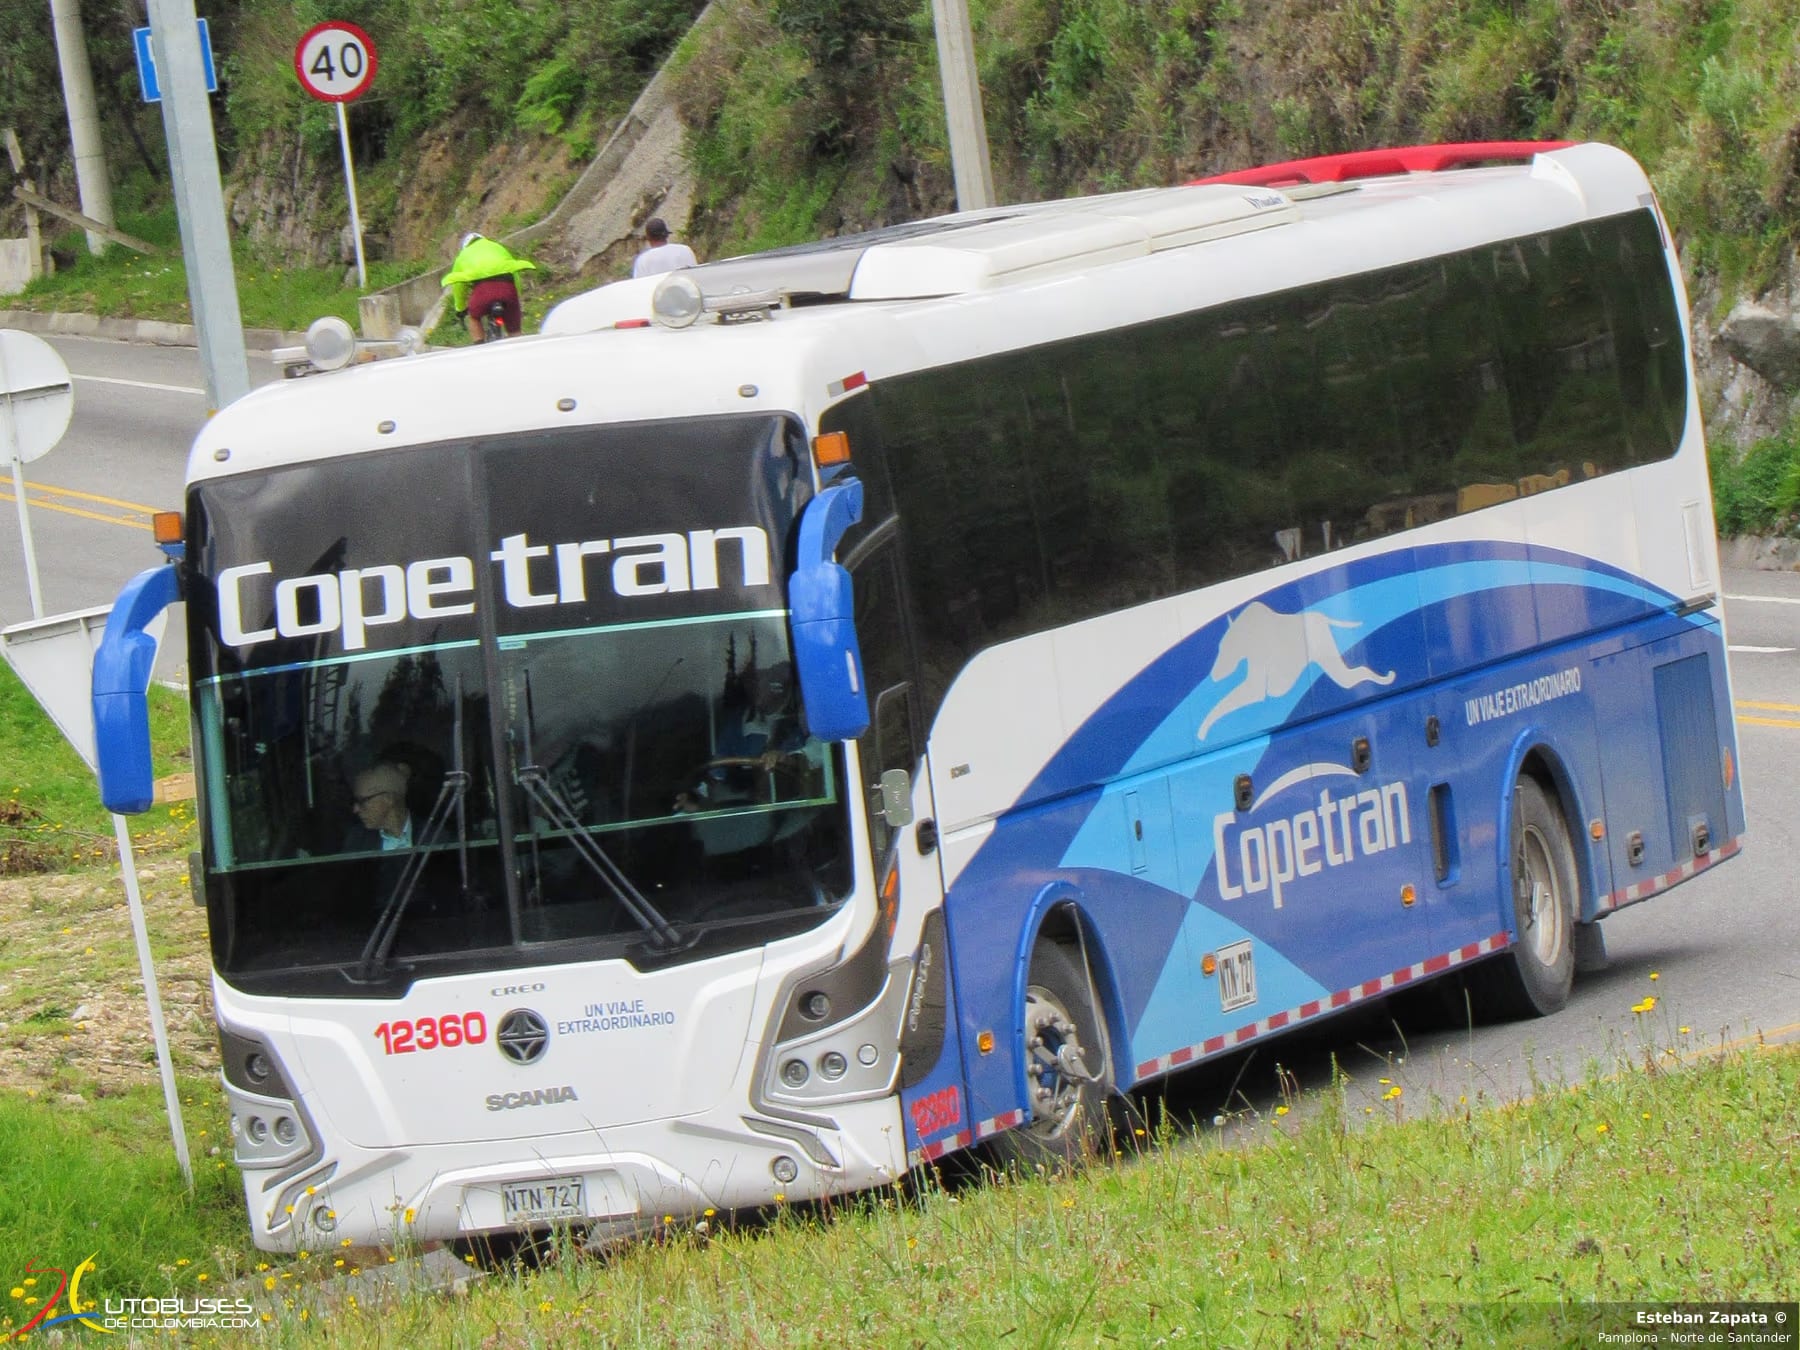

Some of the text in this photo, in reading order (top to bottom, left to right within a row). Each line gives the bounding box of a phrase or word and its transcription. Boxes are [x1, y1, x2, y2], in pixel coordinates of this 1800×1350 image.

[310, 42, 363, 81] 40
[1465, 666, 1581, 727] UN VIAJE EXTRAORDINARIO
[1213, 781, 1411, 909] Copetran
[491, 983, 546, 998] CREO
[557, 1011, 675, 1035] EXTRAORDINARIO
[585, 999, 645, 1018] UN VIAJE
[374, 1010, 488, 1056] 12360
[486, 1085, 579, 1112] SCANIA
